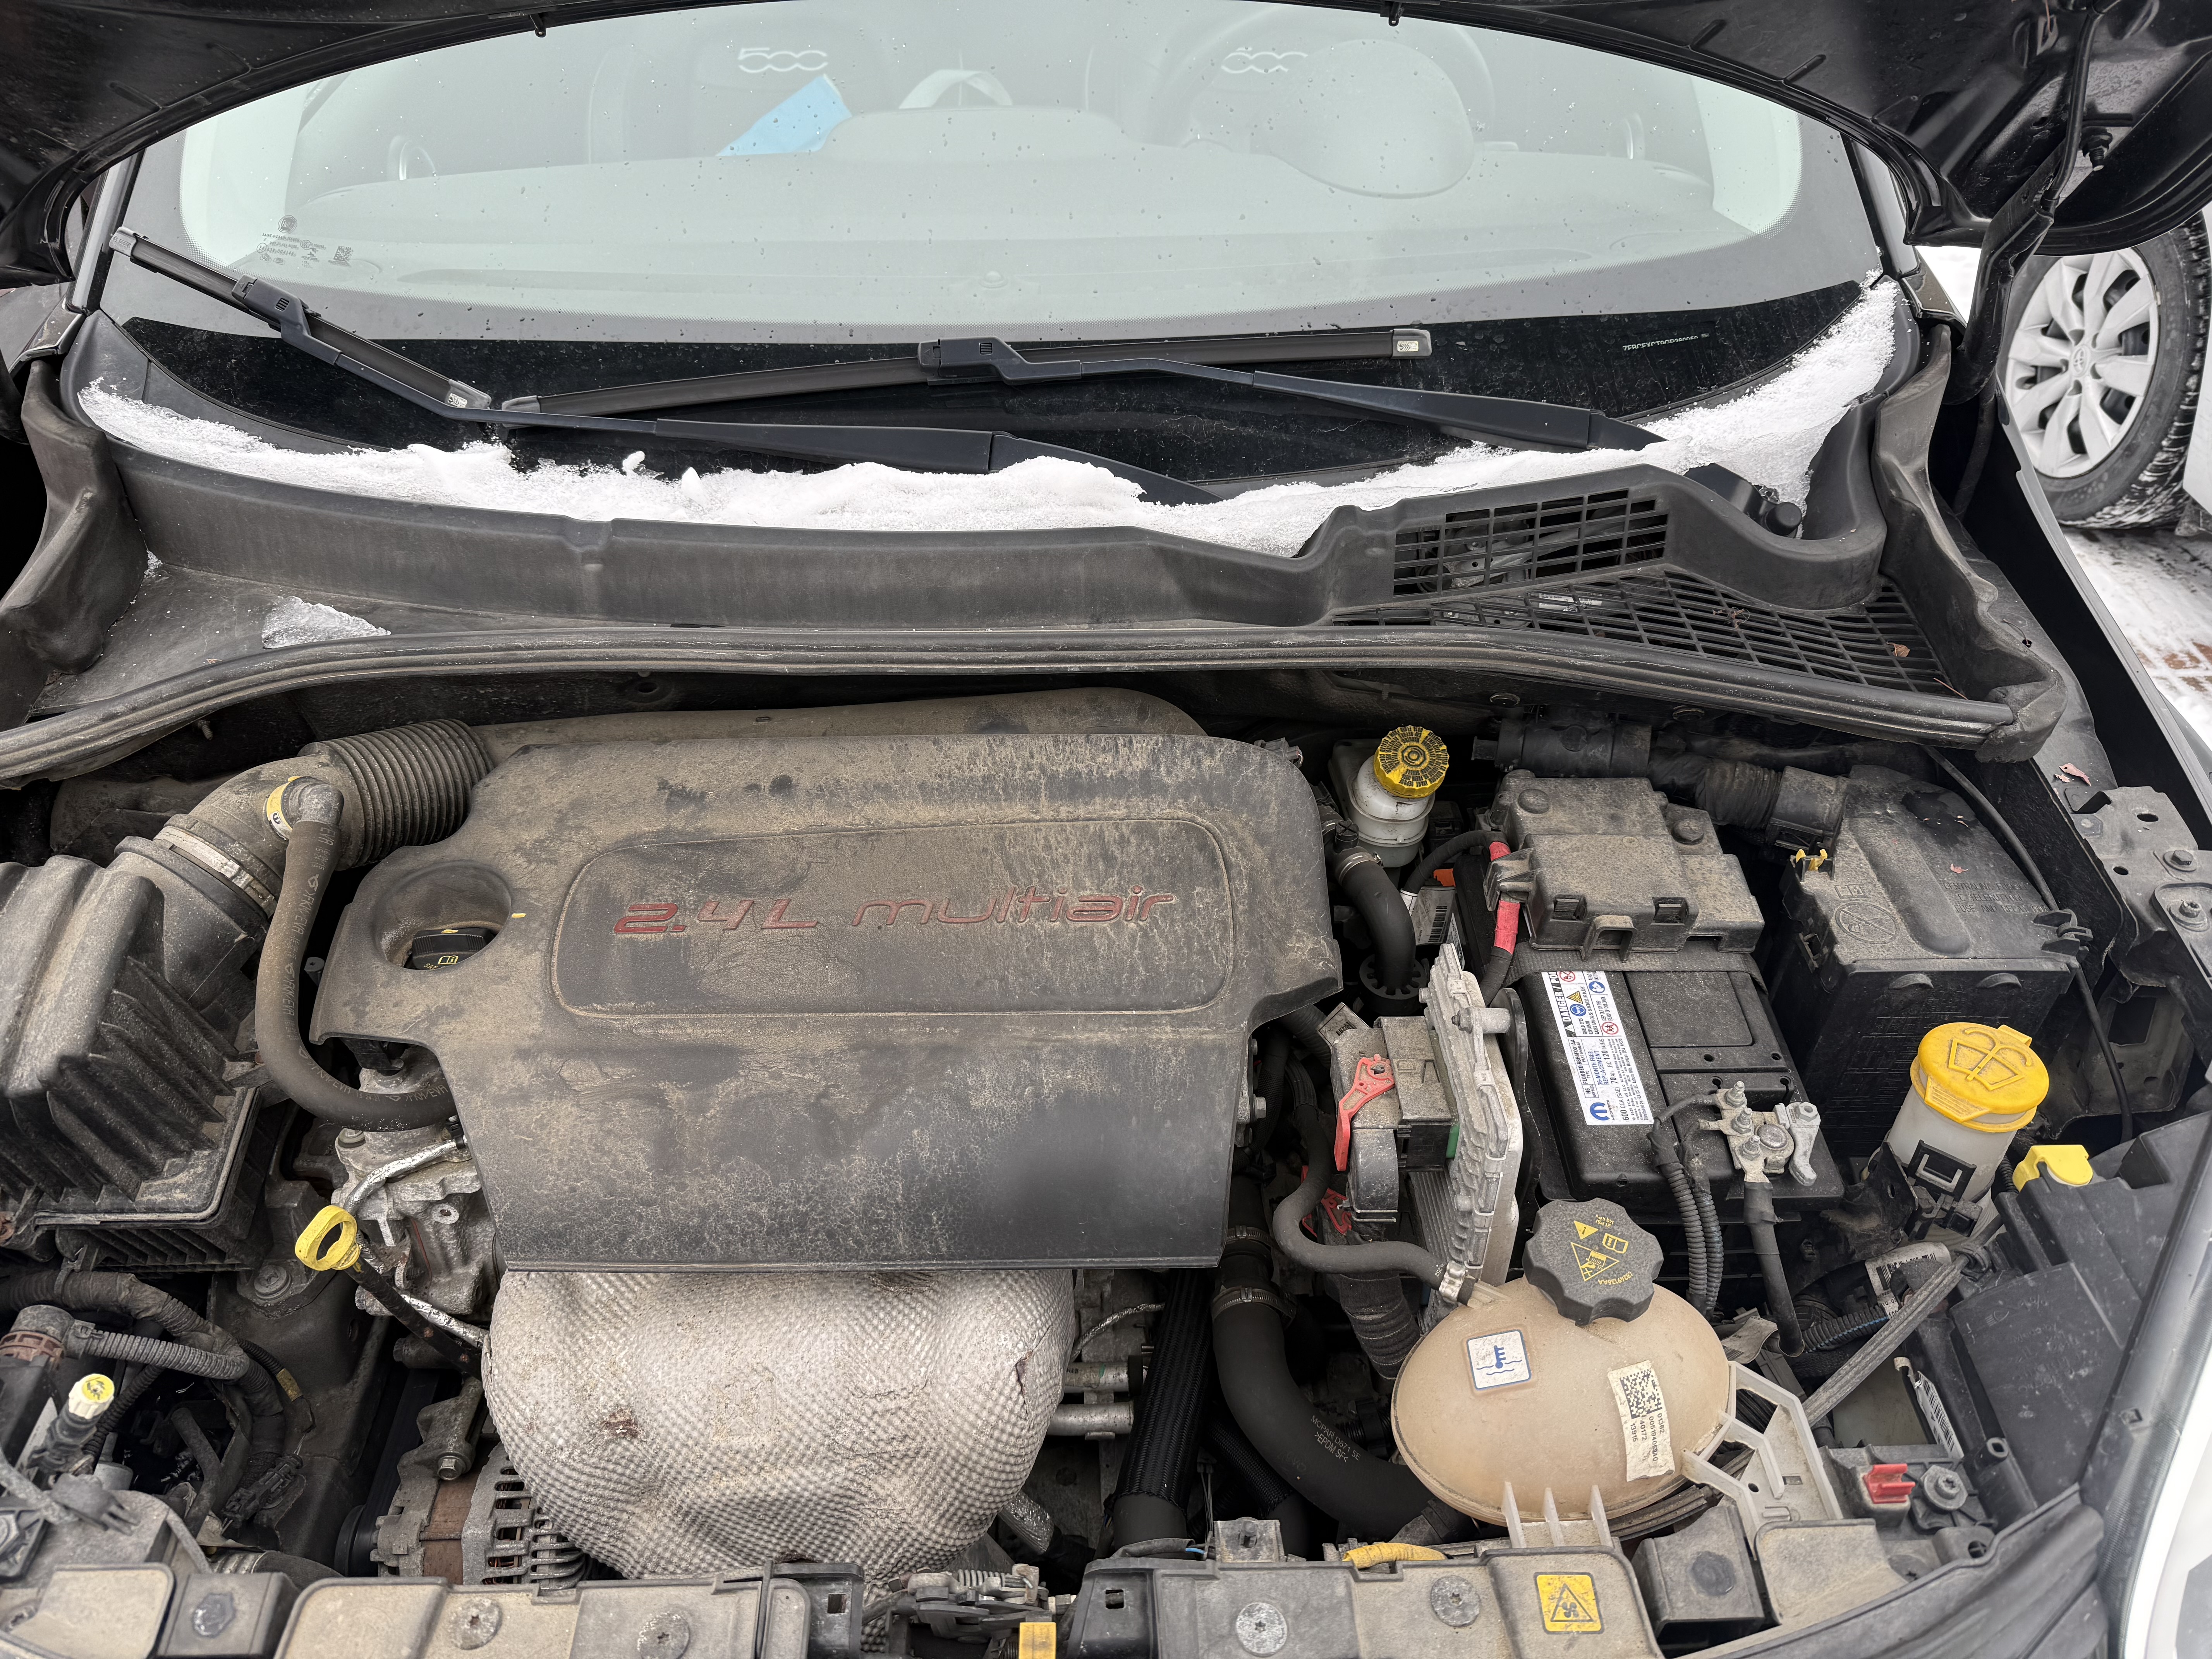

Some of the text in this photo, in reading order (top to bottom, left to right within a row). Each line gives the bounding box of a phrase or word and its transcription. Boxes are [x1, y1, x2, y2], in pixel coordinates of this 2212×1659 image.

[738, 47, 828, 73] 500
[853, 885, 1175, 927] multiair
[1554, 991, 1571, 1022] DANGER
[1598, 1038, 1607, 1048] MINS
[1601, 1050, 1610, 1060] 120
[1578, 1065, 1588, 1084] FLOODED
[1587, 1051, 1603, 1085] 36-MONTH FREE
[1593, 1050, 1609, 1085] REPLACEMENT
[1614, 1087, 1624, 1098] (SAE)
[1618, 1099, 1626, 1108] CCA
[1620, 1109, 1630, 1120] 600
[1311, 1415, 1335, 1440] MOPAR
